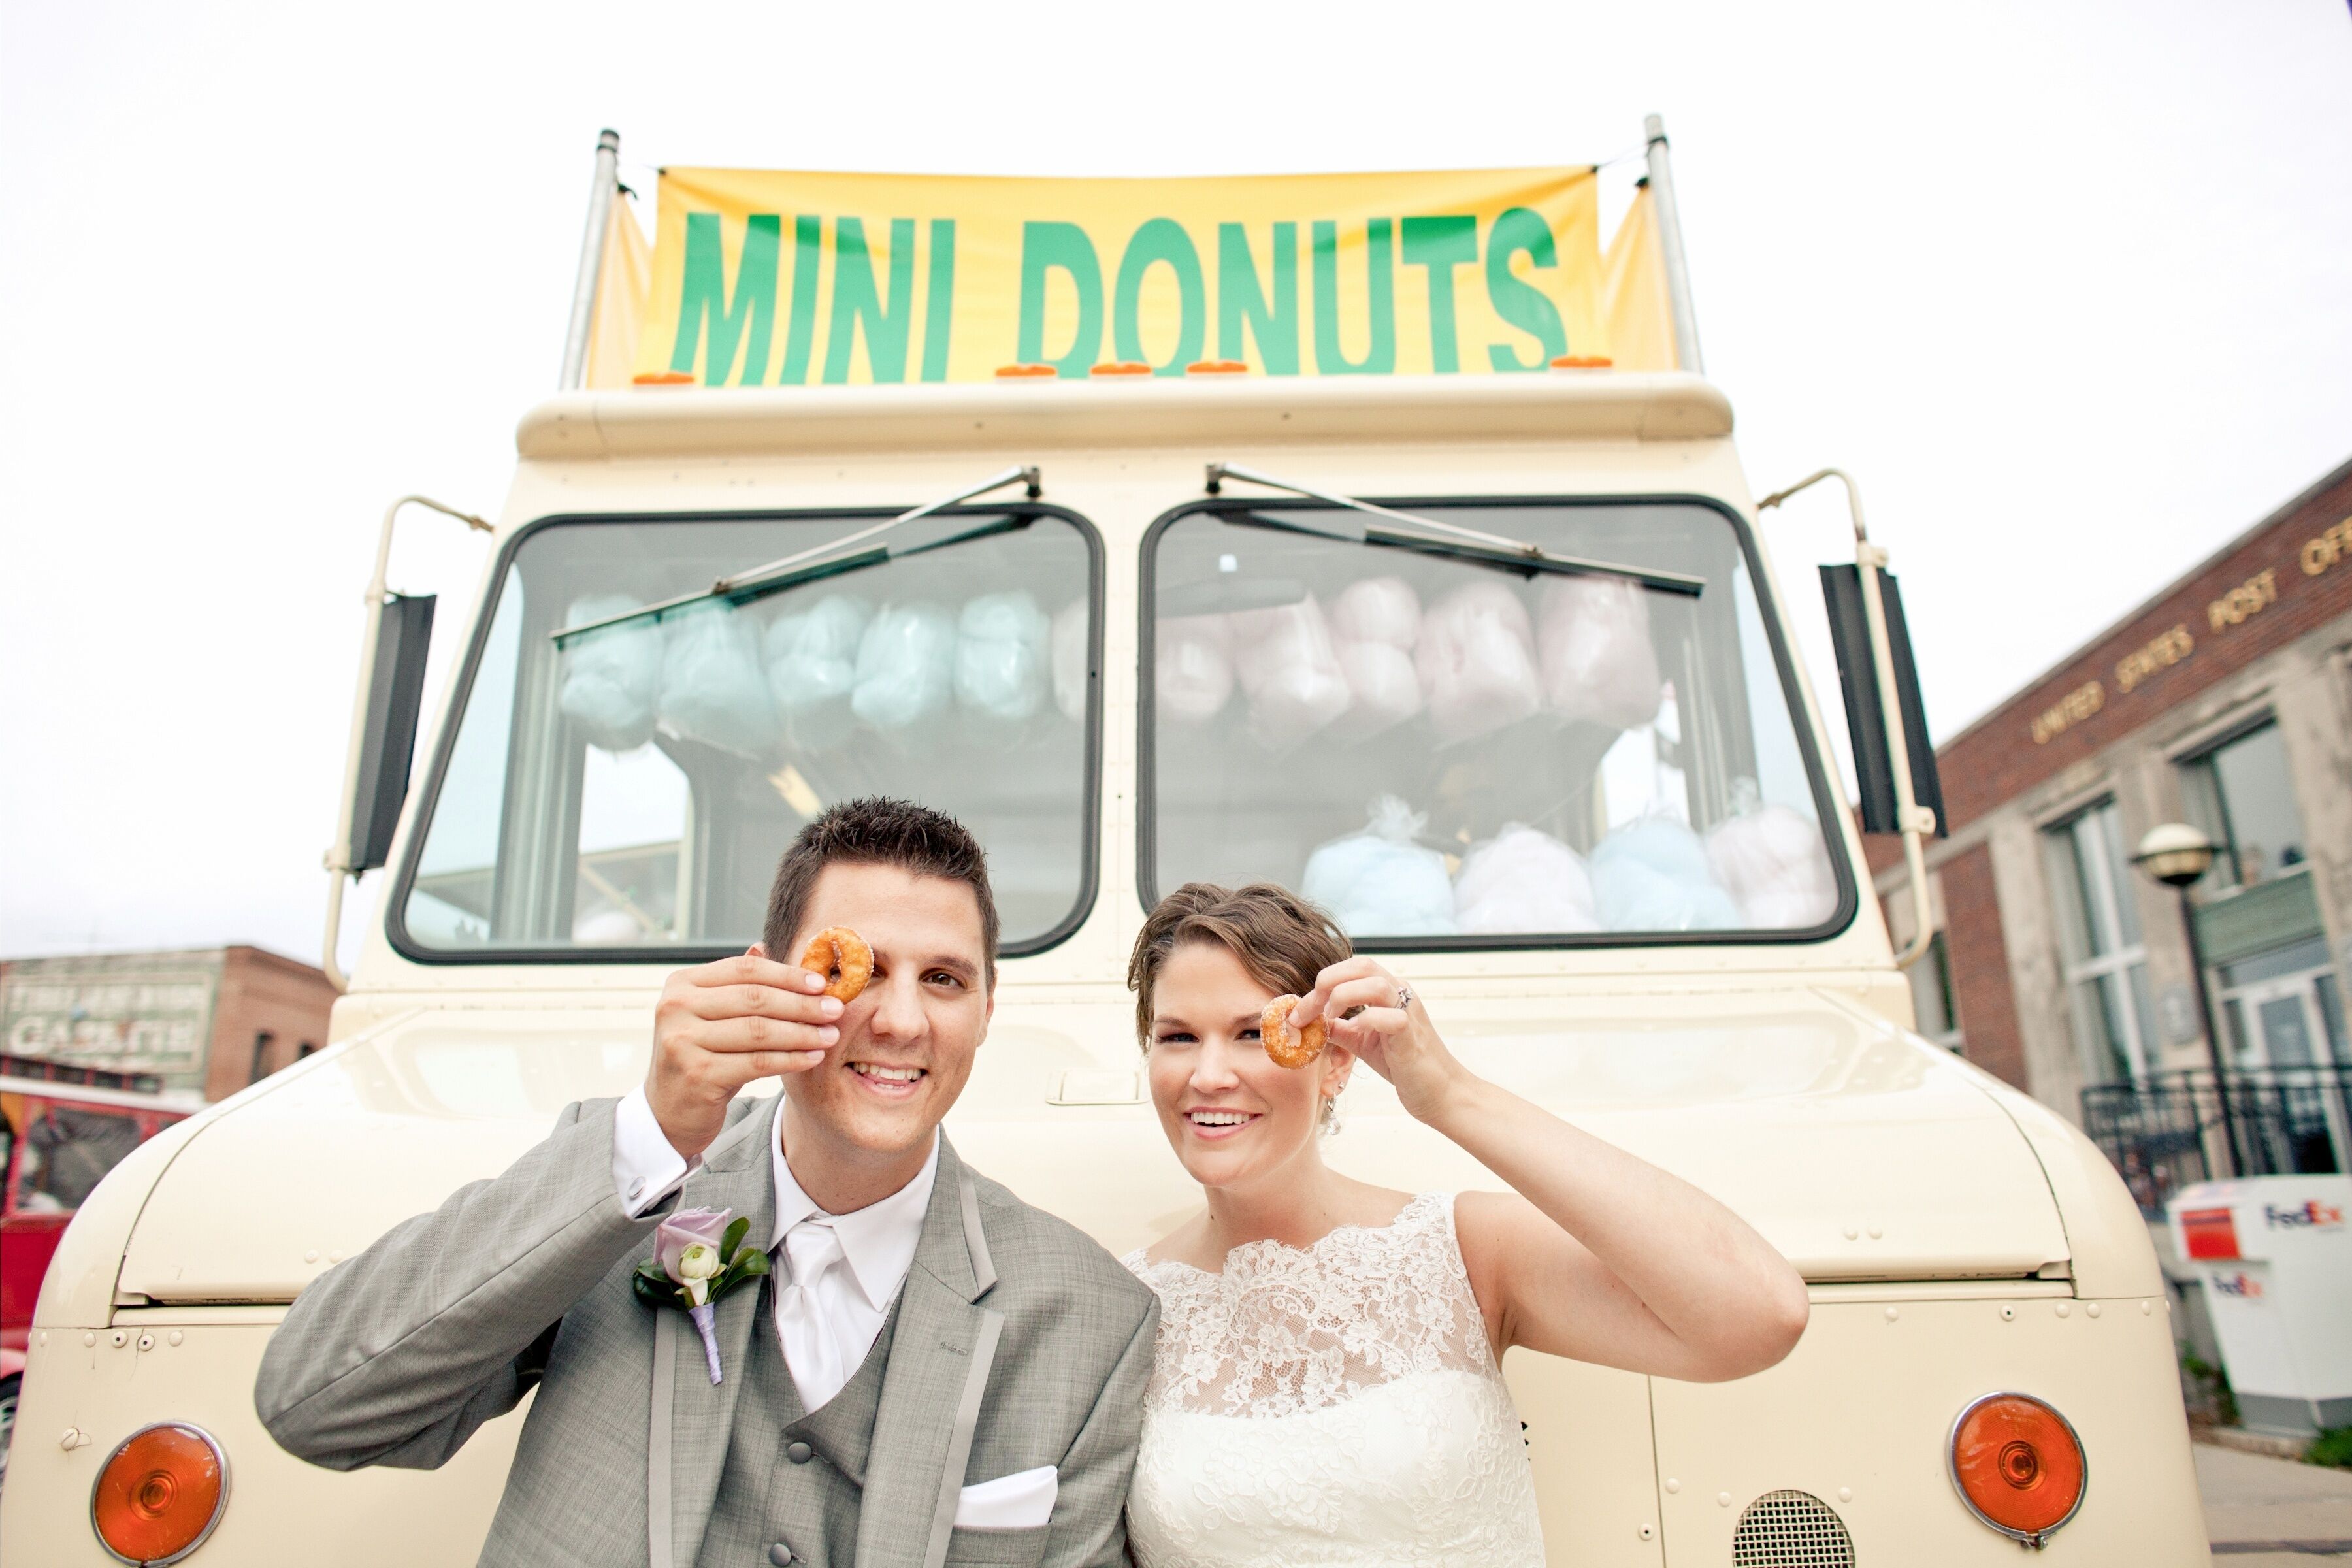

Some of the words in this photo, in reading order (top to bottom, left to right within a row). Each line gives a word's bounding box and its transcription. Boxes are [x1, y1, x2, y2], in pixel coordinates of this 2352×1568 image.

[668, 212, 956, 387] MINI
[1017, 208, 1567, 378] DONUTS
[2207, 566, 2276, 634] POST
[2265, 1200, 2343, 1229] FedEx
